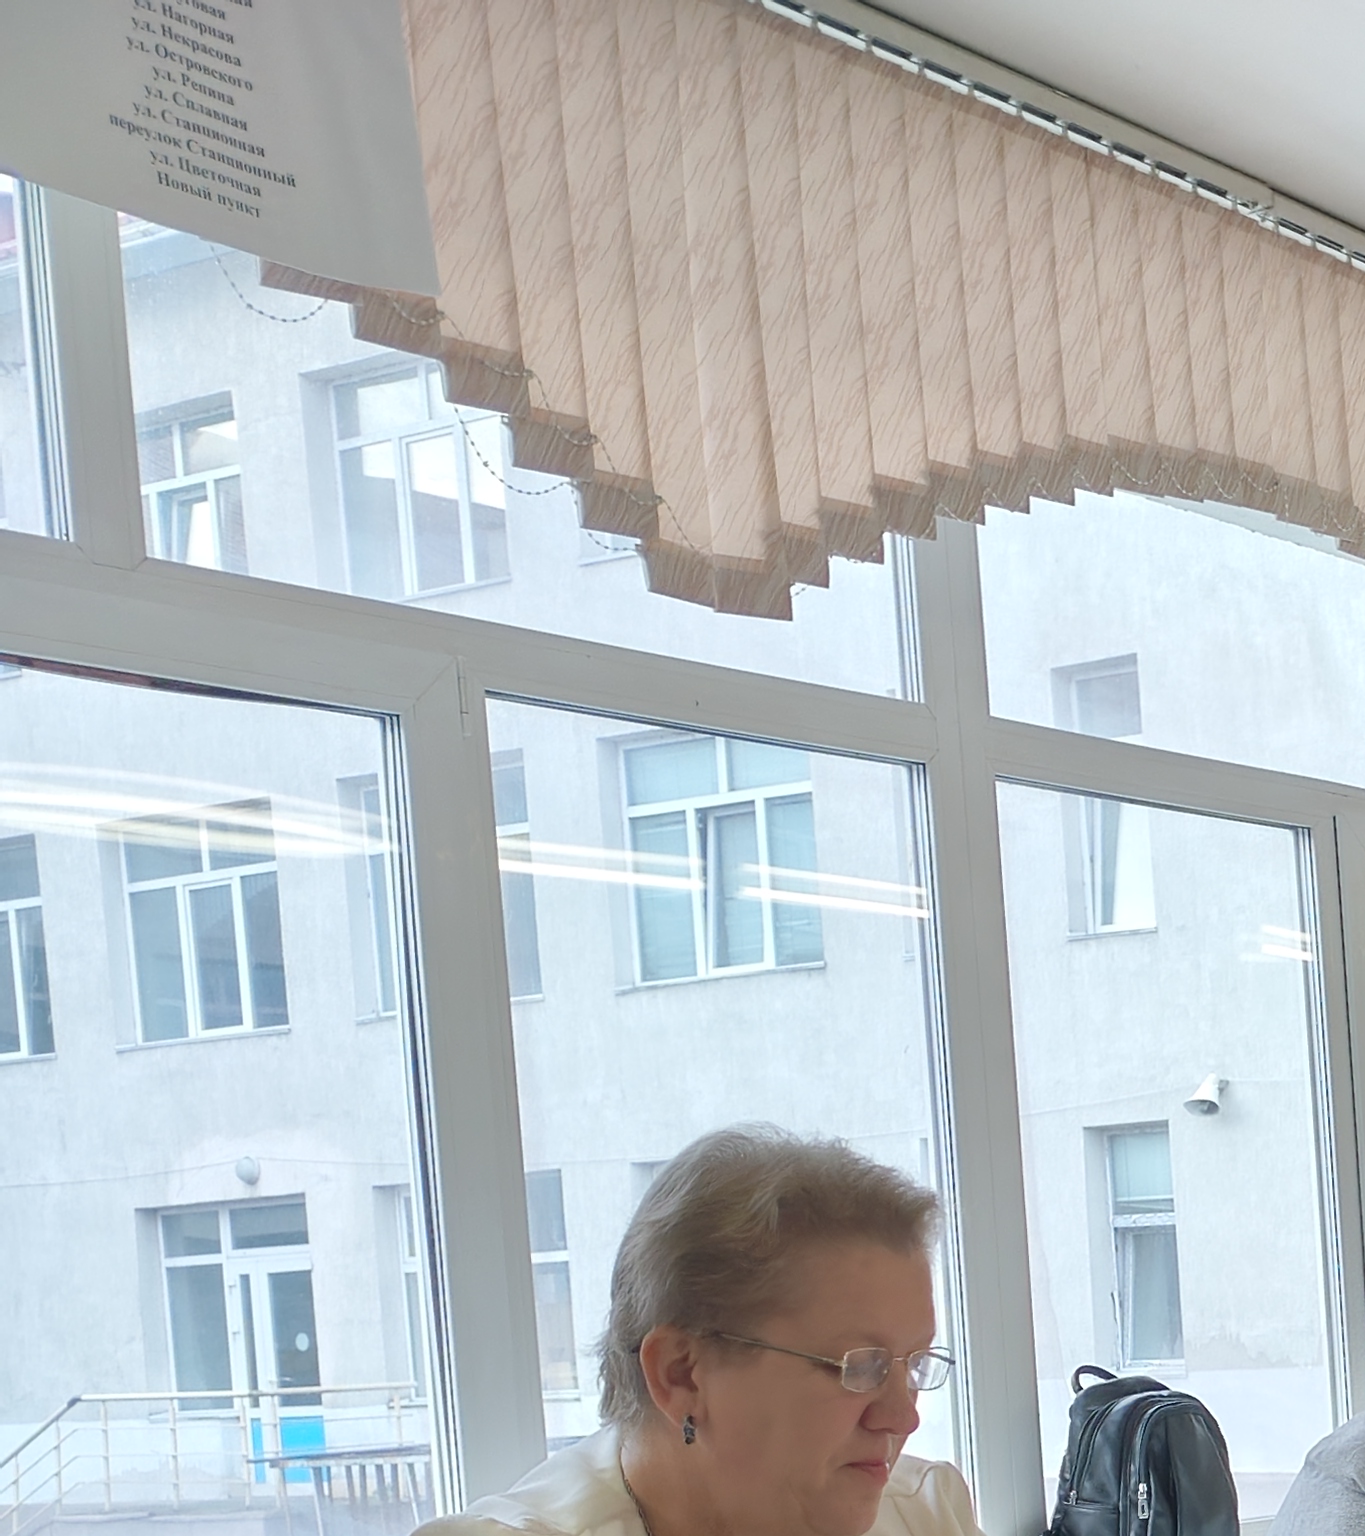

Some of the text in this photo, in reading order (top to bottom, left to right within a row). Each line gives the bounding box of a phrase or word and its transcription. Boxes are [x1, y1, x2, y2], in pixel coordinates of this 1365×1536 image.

[131, 16, 242, 67] ул. Некрасова
[161, 3, 235, 44] Нагорная
[125, 36, 253, 91] ул. Островского
[152, 66, 235, 106] ул. Репина
[132, 102, 265, 157] ул. Станционная
[144, 84, 248, 131] ул. Сплавная
[109, 114, 296, 187] переулок Станционный
[149, 150, 261, 198] ул. Цветочная
[156, 170, 261, 218] Новый пункт
